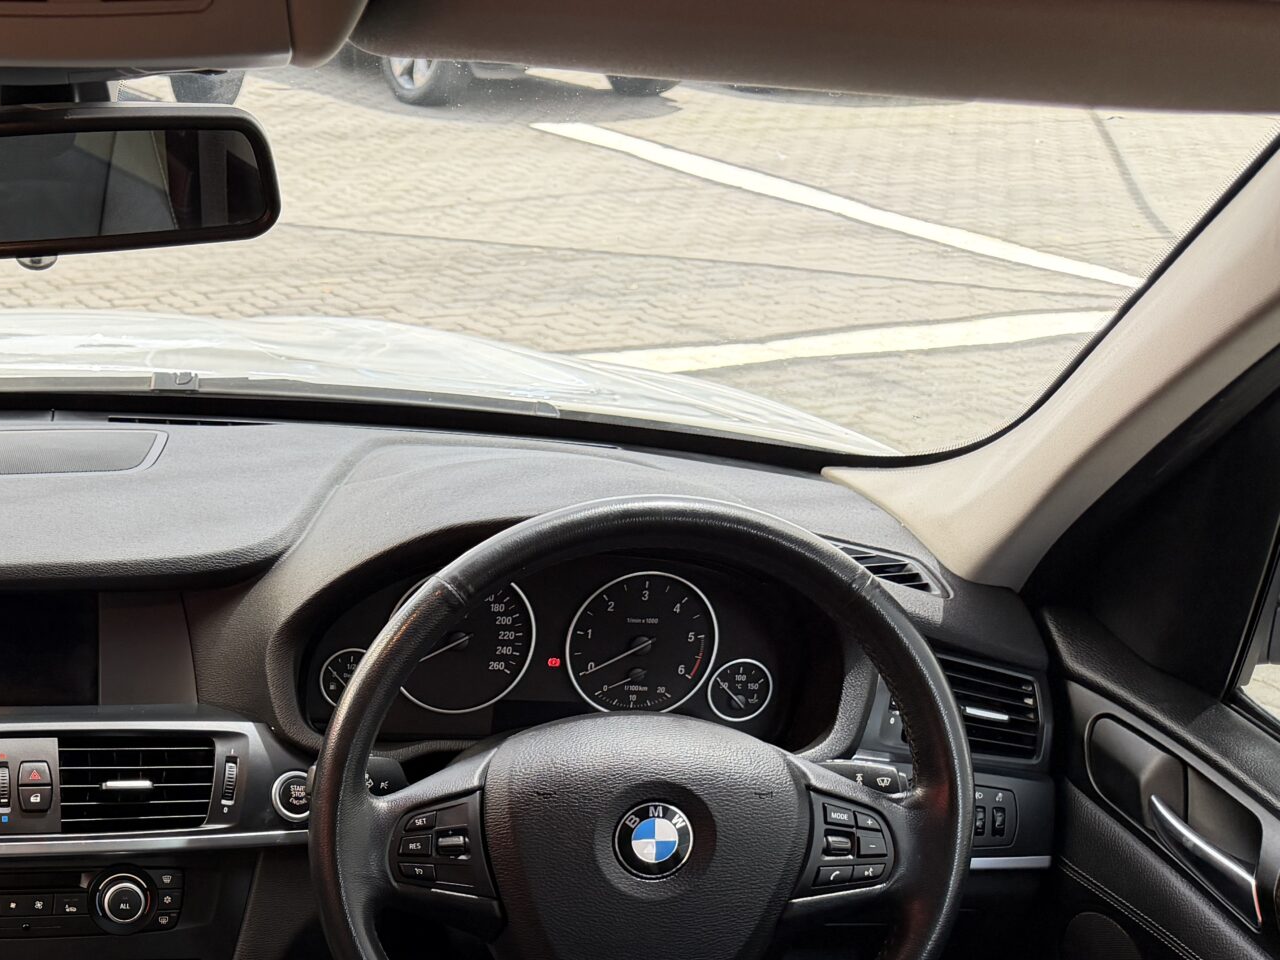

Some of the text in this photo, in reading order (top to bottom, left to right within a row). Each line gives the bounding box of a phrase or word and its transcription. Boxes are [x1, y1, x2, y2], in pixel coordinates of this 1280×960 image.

[641, 590, 649, 601] 3
[490, 603, 505, 612] 180
[607, 601, 615, 612] 2
[673, 602, 681, 613] 4
[495, 616, 512, 625] 200
[498, 631, 515, 640] 220
[587, 629, 592, 639] 1
[688, 632, 695, 642] 5
[495, 646, 513, 655] 240
[488, 661, 505, 670] 260
[587, 661, 595, 673] 0
[678, 664, 685, 675] 6
[735, 674, 747, 682] 100
[657, 686, 665, 694] 20
[624, 806, 687, 829] BMW
[831, 811, 849, 821] MODE
[415, 818, 426, 826] SET
[409, 842, 421, 850] RES
